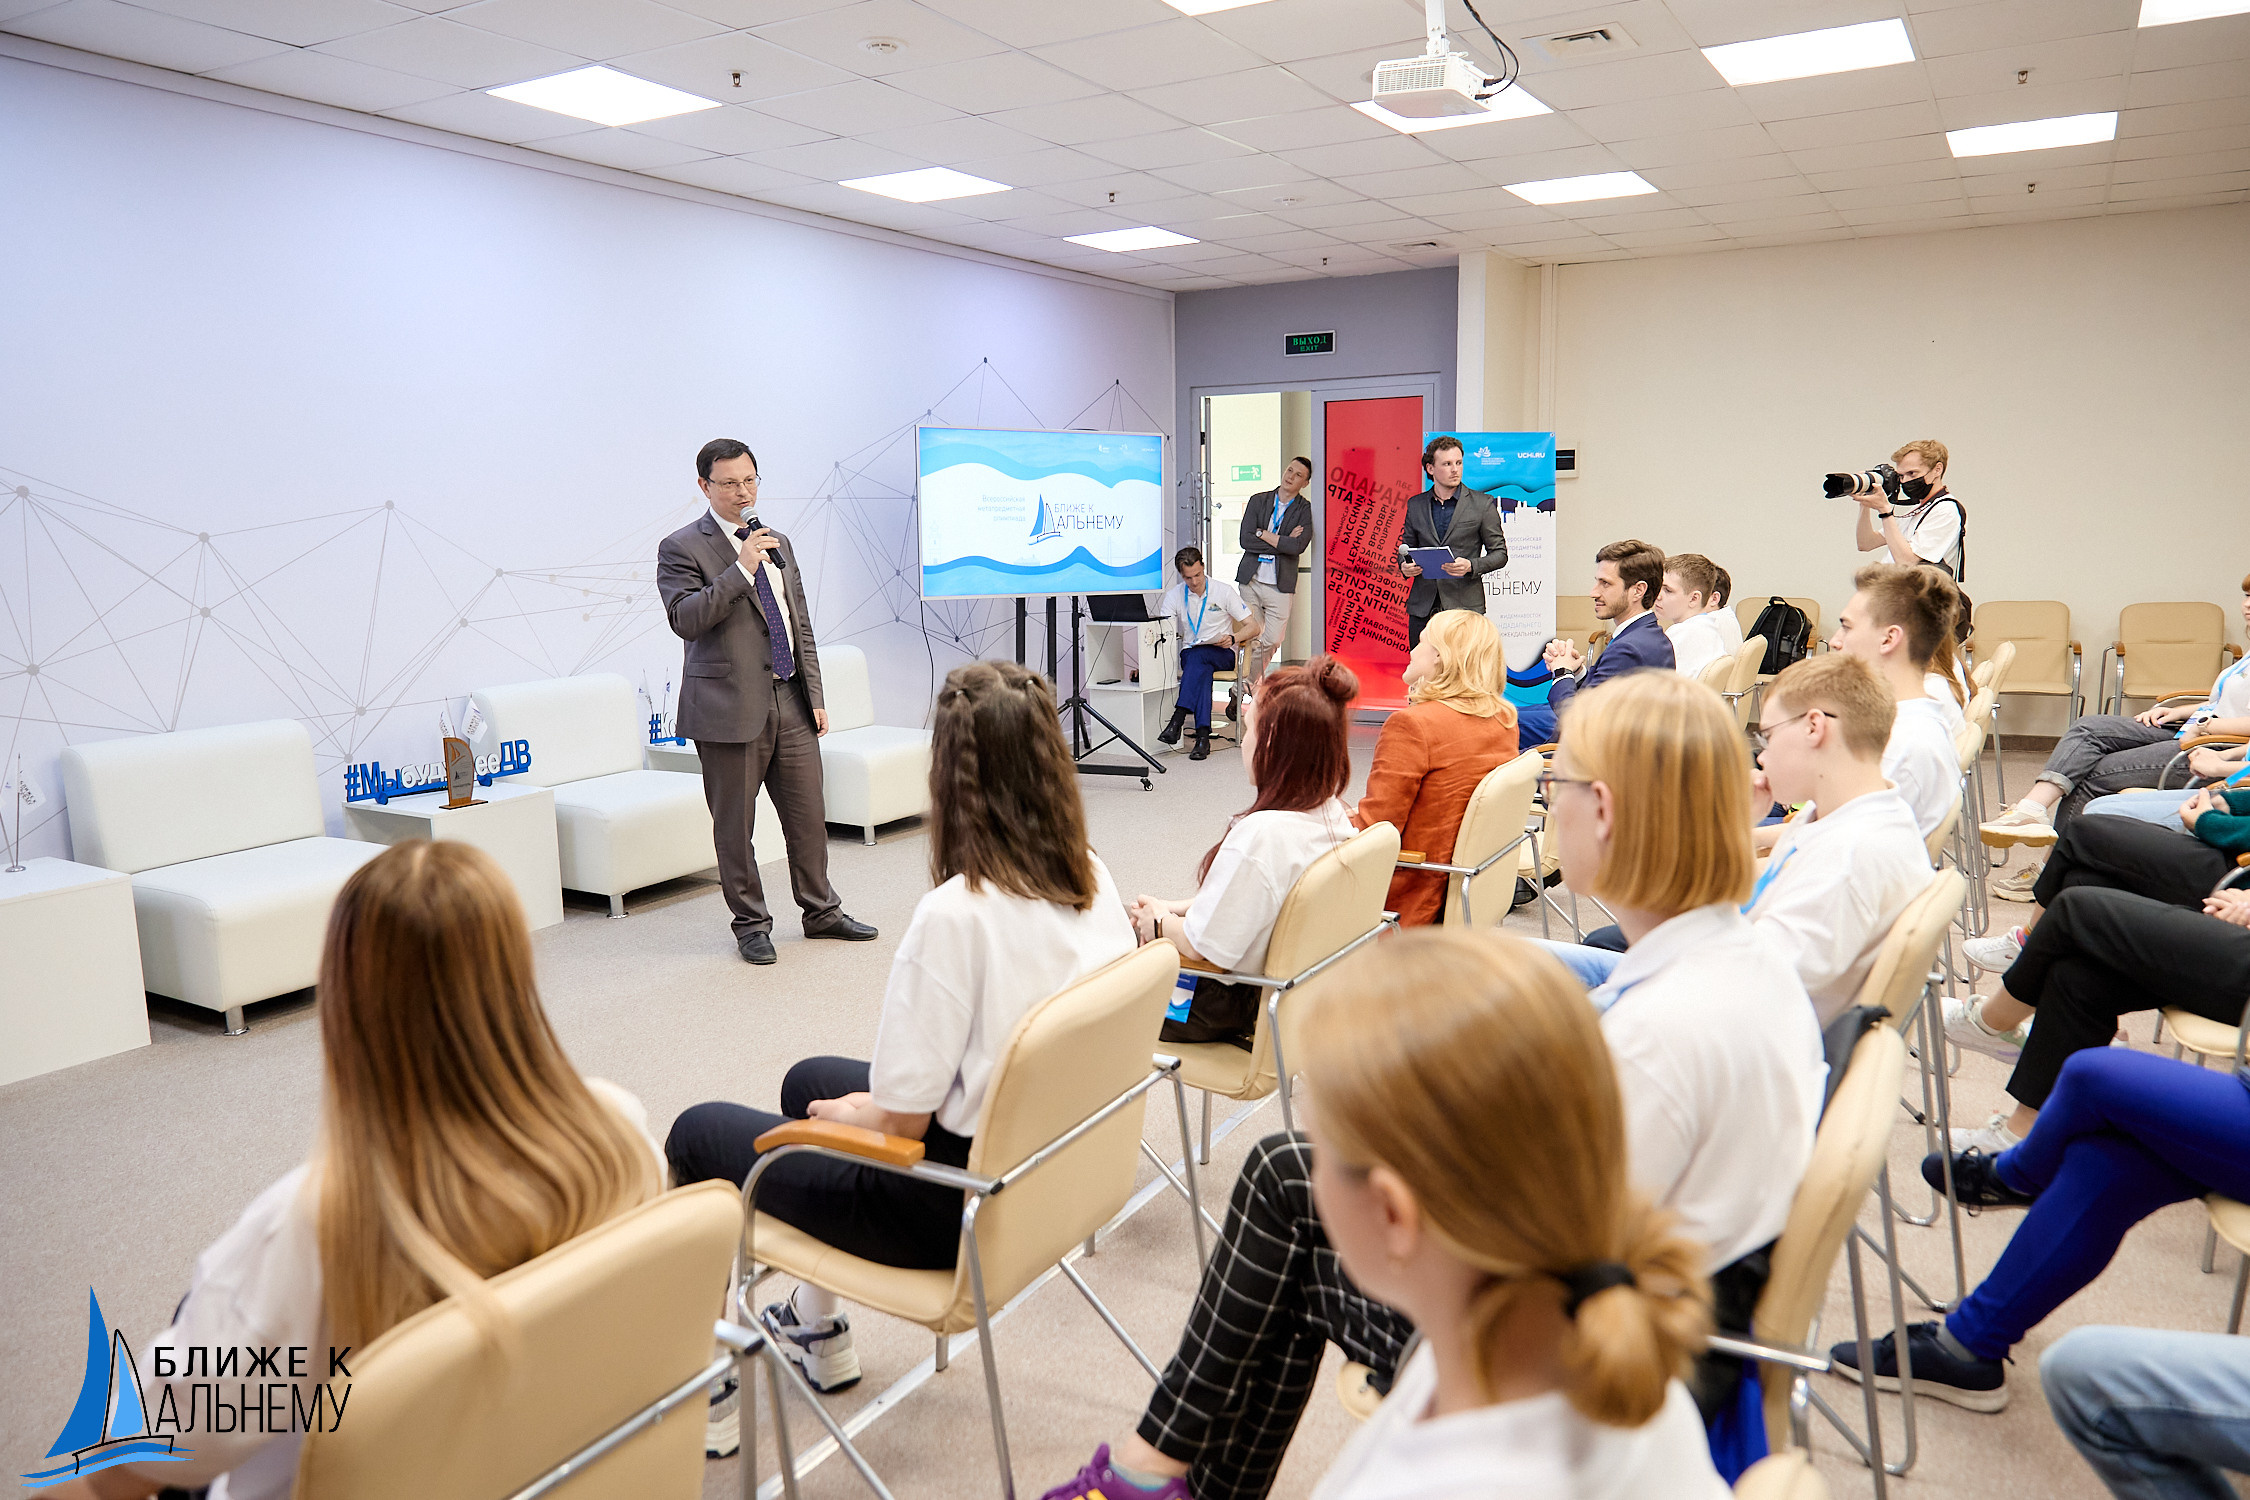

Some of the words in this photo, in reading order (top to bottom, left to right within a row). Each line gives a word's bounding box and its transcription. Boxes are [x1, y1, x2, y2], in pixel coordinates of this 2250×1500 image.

[1292, 335, 1327, 346] ВЫХОД
[1054, 503, 1085, 513] БЛИЖЕ
[1088, 503, 1094, 513] К
[1504, 571, 1511, 579] К
[1483, 580, 1542, 596] ЛЬНЕМУ
[344, 739, 532, 797] #МыбудееДВ
